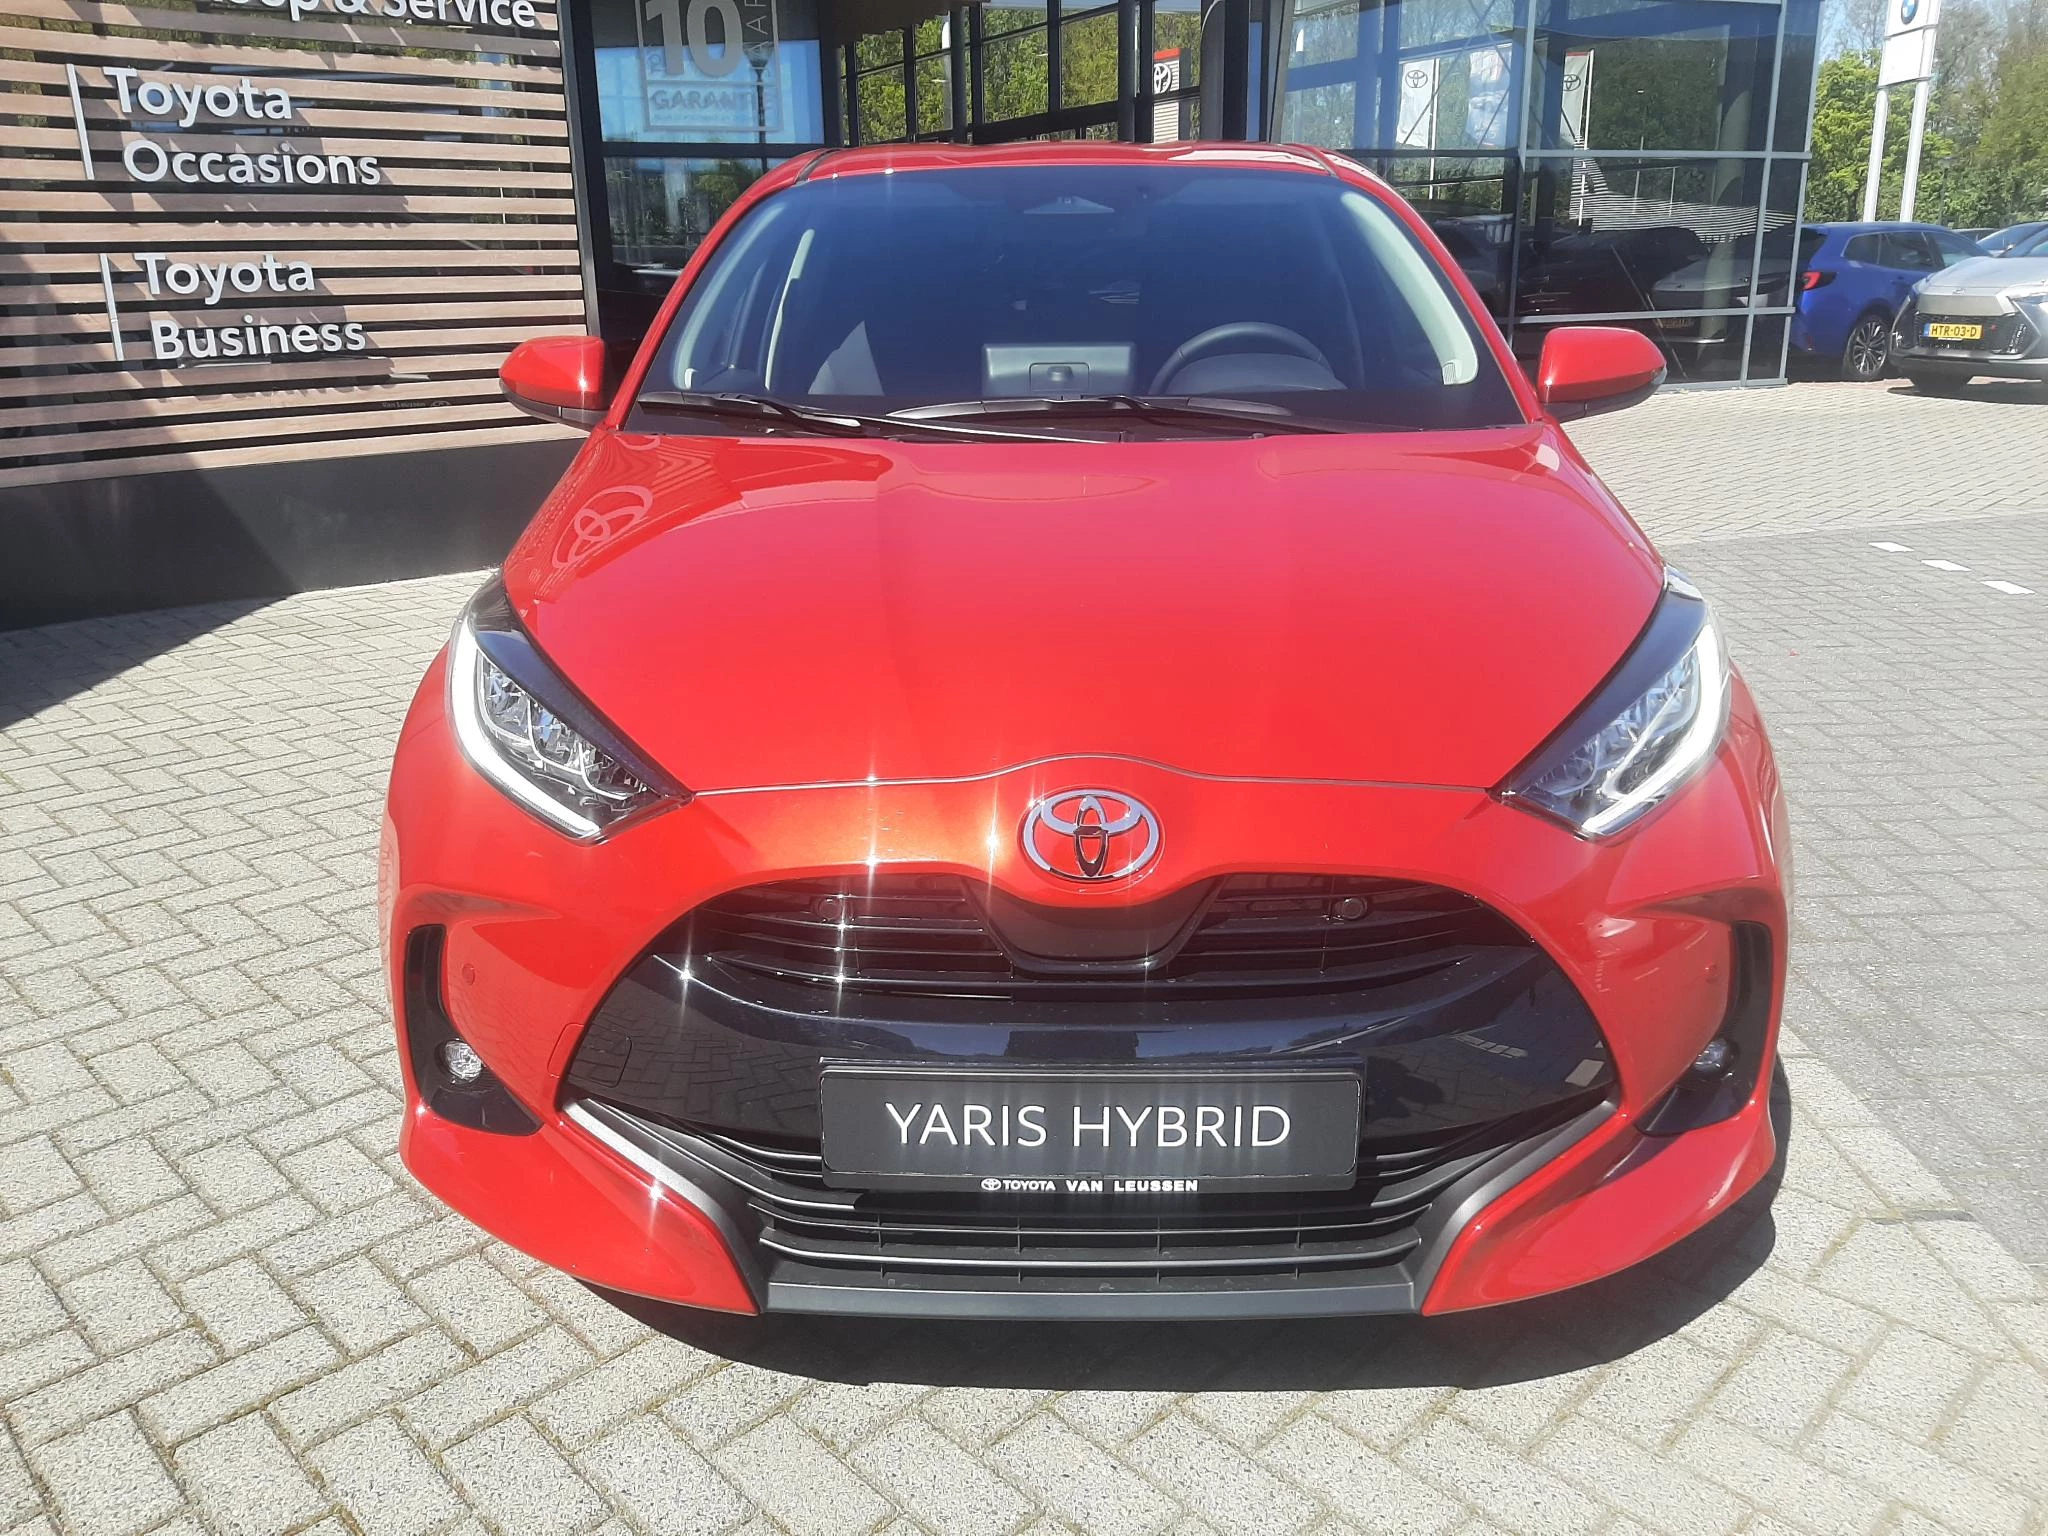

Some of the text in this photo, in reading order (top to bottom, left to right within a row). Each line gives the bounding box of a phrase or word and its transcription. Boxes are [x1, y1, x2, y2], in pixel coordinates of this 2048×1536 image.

[646, 0, 743, 78] 10
[103, 66, 292, 128] Toyota
[123, 139, 381, 185] Occasions
[134, 253, 316, 305] Toyota
[151, 314, 366, 360] Business
[1931, 325, 1977, 337] HTR-03-D
[885, 1102, 1291, 1148] YARIS HYBRID
[1002, 1179, 1199, 1192] TOYOTA VAN LEUSSEN
